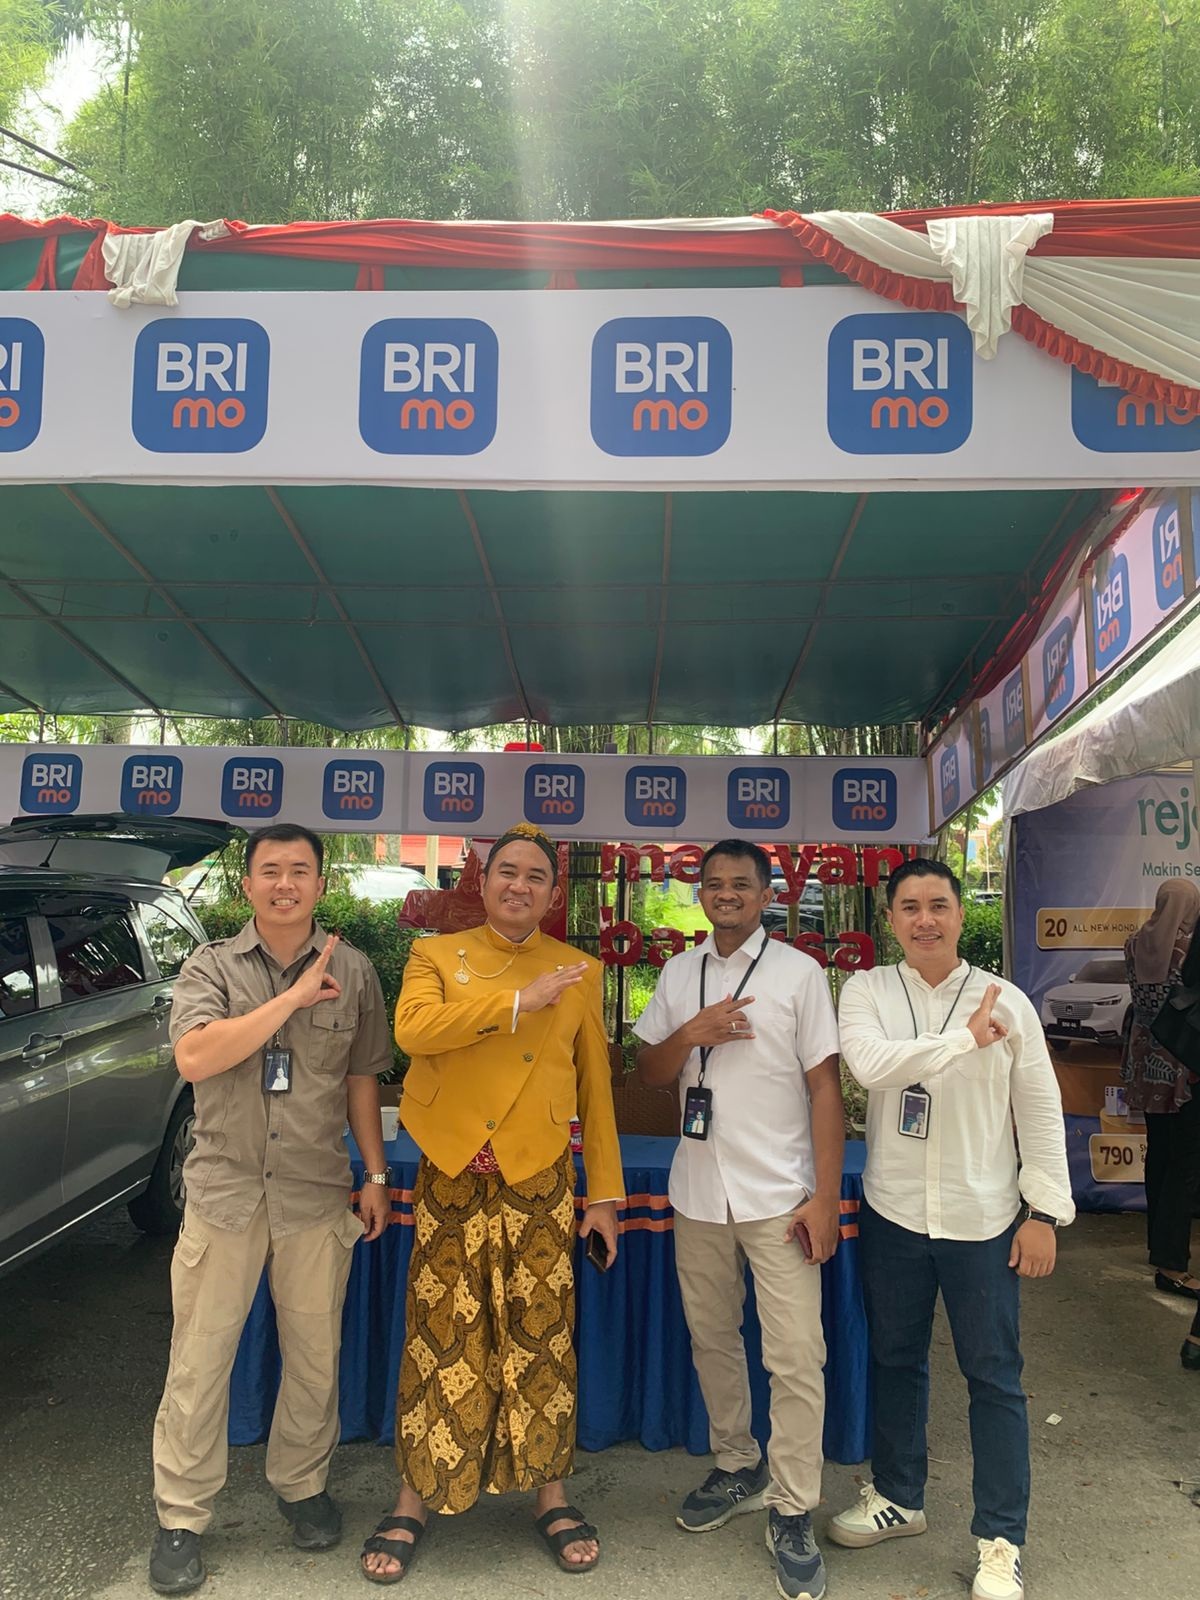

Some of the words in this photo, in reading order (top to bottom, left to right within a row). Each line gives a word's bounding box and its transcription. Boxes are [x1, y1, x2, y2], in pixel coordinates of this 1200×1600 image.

[157, 343, 247, 391] BRI
[383, 343, 475, 392] BRI
[615, 342, 708, 393] BRI
[852, 338, 948, 391] BRI
[0, 397, 20, 428] o
[172, 398, 246, 428] mo
[400, 399, 475, 430] mo
[633, 400, 709, 431] mo
[871, 397, 949, 428] mo
[31, 764, 73, 788] BRI
[131, 765, 172, 790] BRI
[232, 768, 274, 791] BRI
[333, 770, 375, 794] BRI
[434, 772, 475, 795] BRI
[534, 775, 575, 798] BRI
[37, 788, 71, 804] mo
[138, 790, 171, 806] mo
[635, 776, 677, 800] BRI
[737, 778, 779, 802] BRI
[843, 779, 886, 803] BRI
[239, 792, 272, 808] mo
[340, 794, 373, 810] mo
[441, 797, 474, 812] mo
[541, 799, 575, 814] mo
[642, 801, 676, 817] mo
[745, 802, 780, 819] mo
[851, 804, 887, 821] mo
[1143, 862, 1181, 876] Makin
[1045, 918, 1067, 937] 20
[1073, 923, 1088, 933] ALL
[1091, 923, 1109, 933] NEW
[1100, 1146, 1133, 1165] 790
